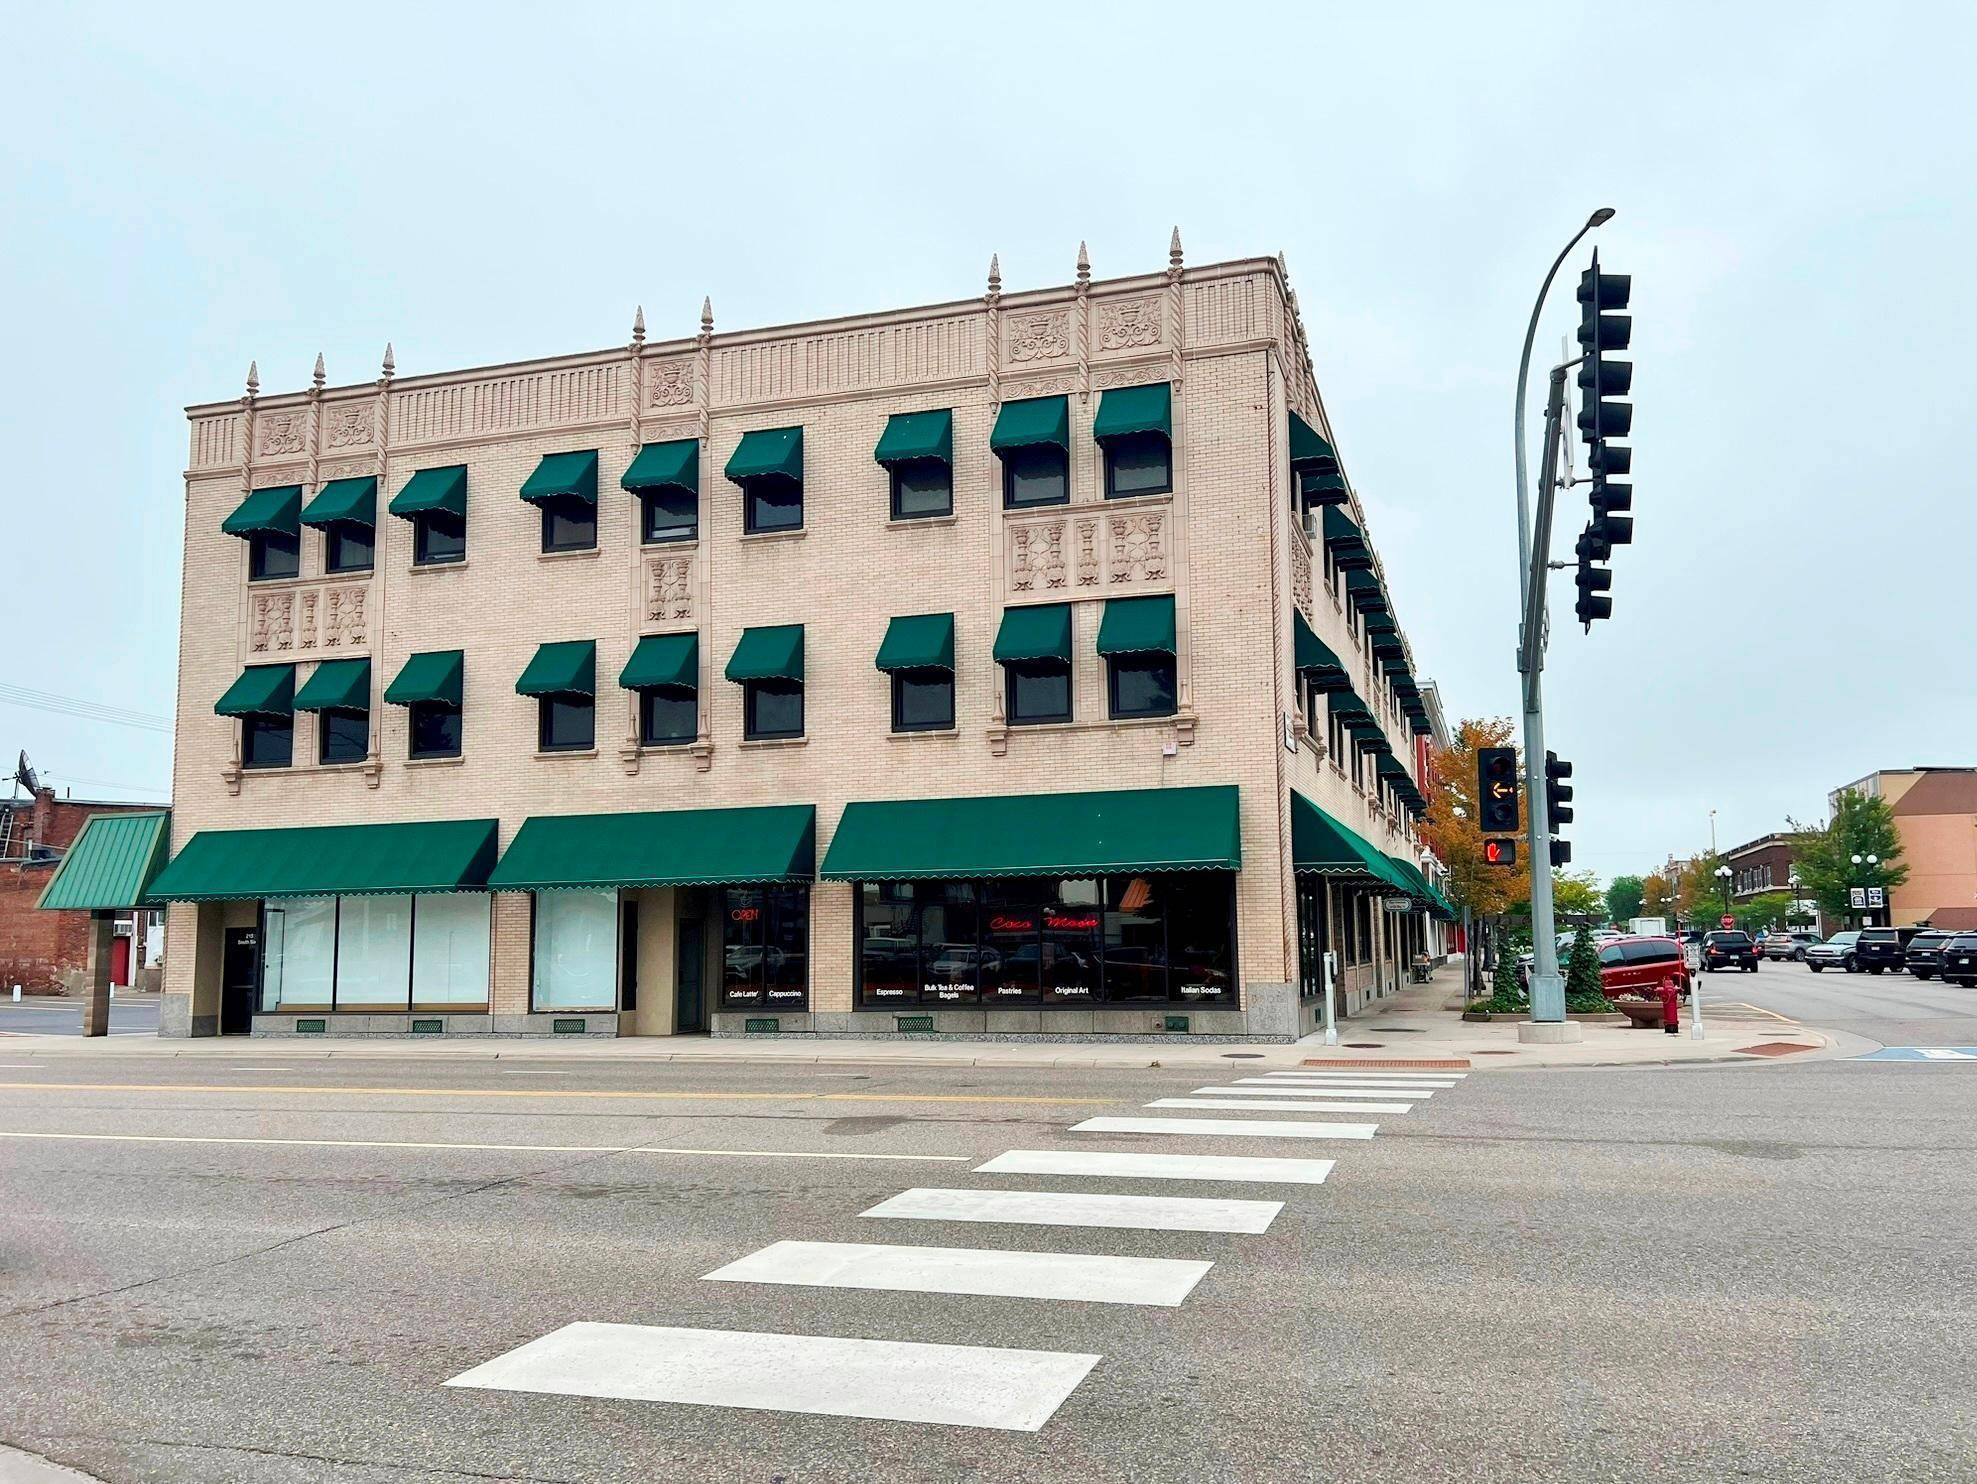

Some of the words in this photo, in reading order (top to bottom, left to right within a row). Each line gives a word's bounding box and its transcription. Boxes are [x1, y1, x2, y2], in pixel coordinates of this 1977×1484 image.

[731, 908, 758, 920] OPEN
[876, 988, 903, 996] Espresso
[998, 987, 1022, 995] Pastries
[1055, 986, 1079, 996] Original
[1079, 986, 1089, 994] Art
[1200, 986, 1221, 994] Sodas
[768, 990, 802, 999] Cappuccino
[939, 992, 959, 1000] Bagels
